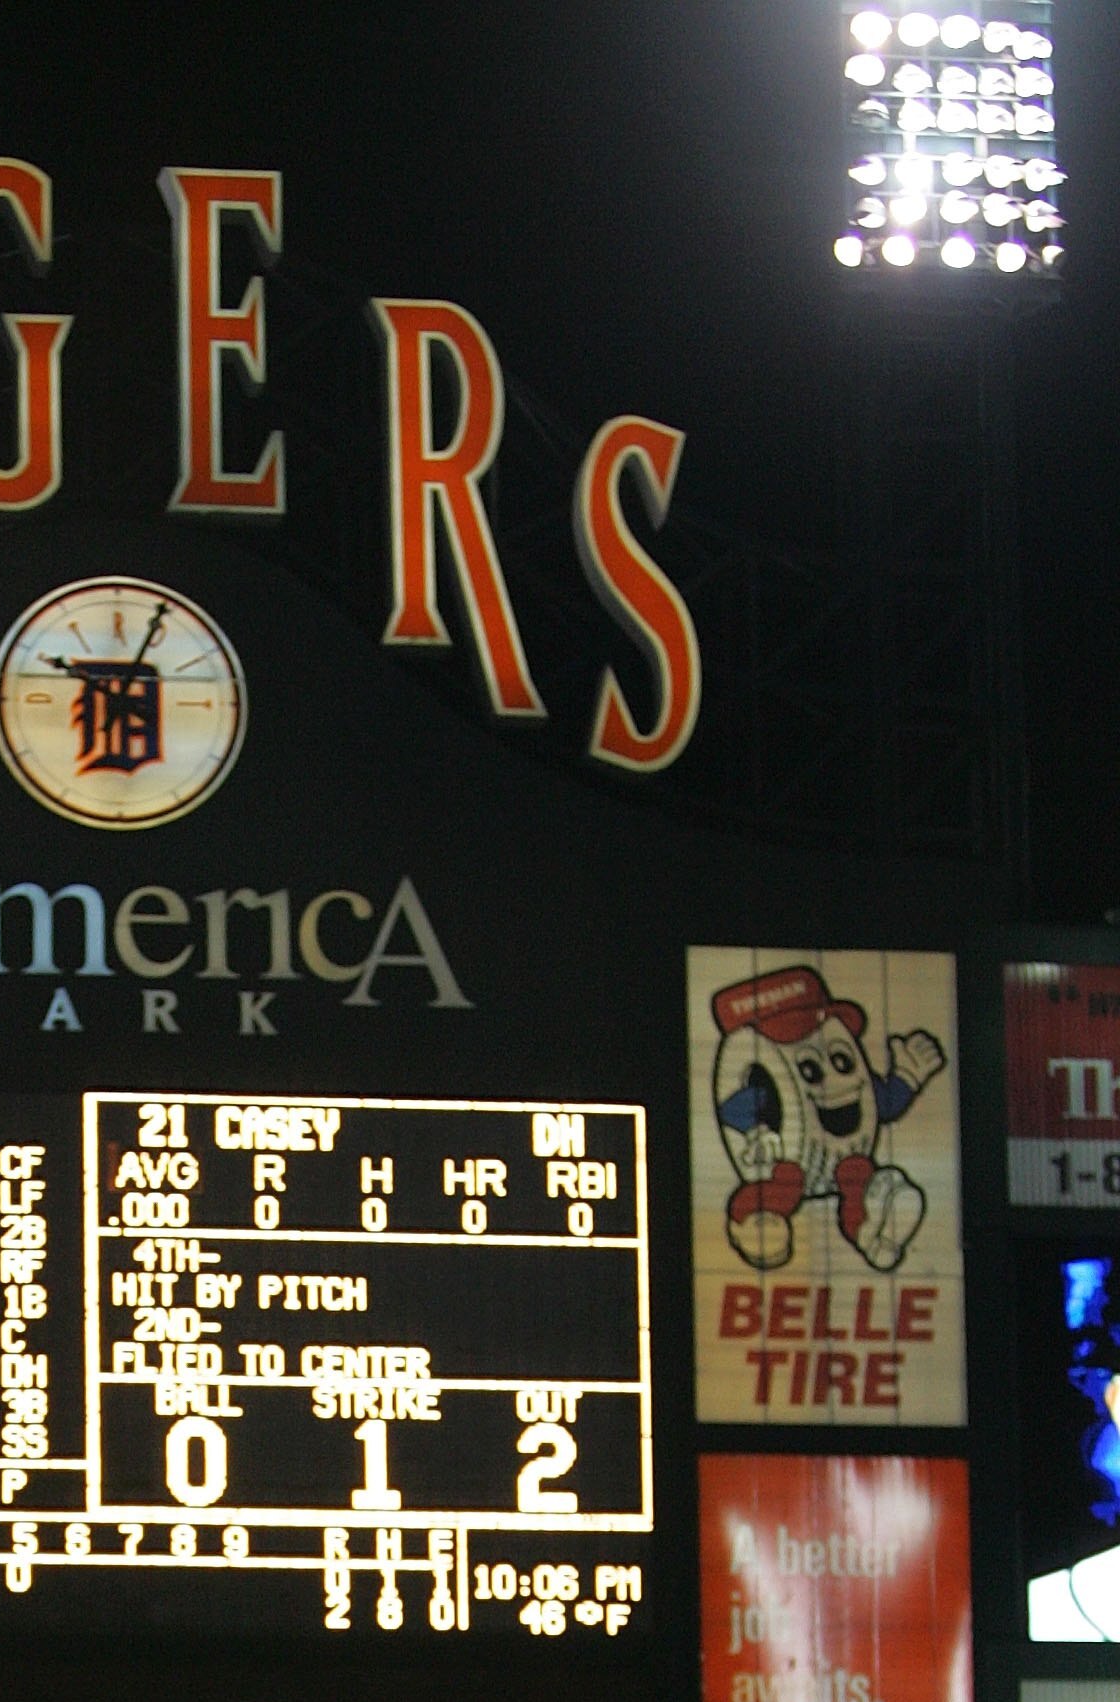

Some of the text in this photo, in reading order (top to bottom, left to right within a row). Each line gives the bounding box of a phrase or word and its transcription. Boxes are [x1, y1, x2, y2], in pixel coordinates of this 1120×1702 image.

[138, 1104, 585, 1158] 21 CASEY DH
[0, 1146, 45, 1180] CF
[115, 1153, 617, 1200] AVG R H HR RBI
[0, 1181, 46, 1214] LF
[107, 1192, 594, 1237] .000 0 0 0 0
[0, 1214, 47, 1249] 2B
[0, 1250, 47, 1284] RF
[133, 1239, 221, 1273] 4TH-
[3, 1284, 48, 1320] 1B
[112, 1273, 368, 1311] HIT BY PITCH
[133, 1308, 221, 1342] 2ND-
[719, 1284, 938, 1341] BELLE
[0, 1319, 27, 1354] C
[0, 1353, 48, 1389] DH
[112, 1342, 431, 1380] FLIED TO CENTER
[746, 1350, 905, 1408] TIRE
[0, 1388, 48, 1424] 3B
[155, 1383, 582, 1424] BALL STRIKE OUT
[0, 1424, 49, 1459] SS
[165, 1415, 578, 1514] 0 1 2
[1, 1469, 29, 1505] P
[11, 1522, 39, 1555] 5
[65, 1522, 91, 1555] 6
[118, 1524, 145, 1557] 7
[170, 1524, 198, 1558] 8
[222, 1526, 250, 1559] 9
[428, 1529, 454, 1561] E
[776, 1525, 898, 1578] better
[474, 1565, 580, 1601] 10:06
[596, 1566, 642, 1602] PM
[324, 1596, 351, 1629] 2
[376, 1596, 404, 1630] 8
[520, 1601, 566, 1636] 46
